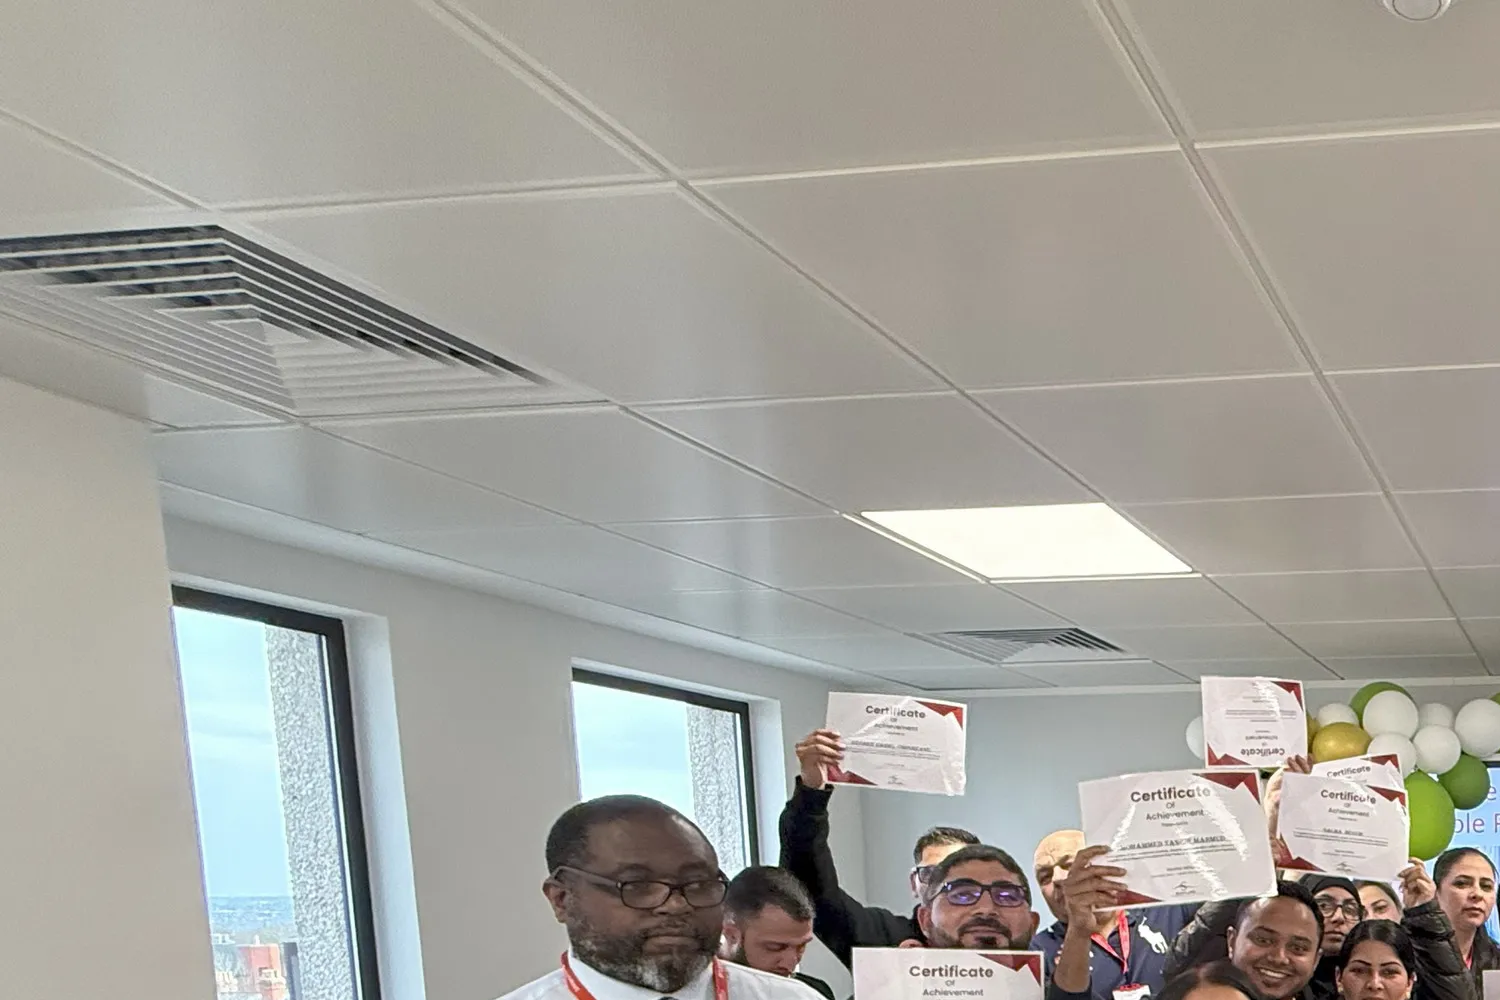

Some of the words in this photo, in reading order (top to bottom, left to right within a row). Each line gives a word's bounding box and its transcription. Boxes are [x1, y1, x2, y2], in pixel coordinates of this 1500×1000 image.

[1130, 786, 1211, 803] Certificate
[1321, 789, 1376, 804] Certificate
[909, 965, 994, 978] Certificate
[922, 988, 984, 997] Achievement
